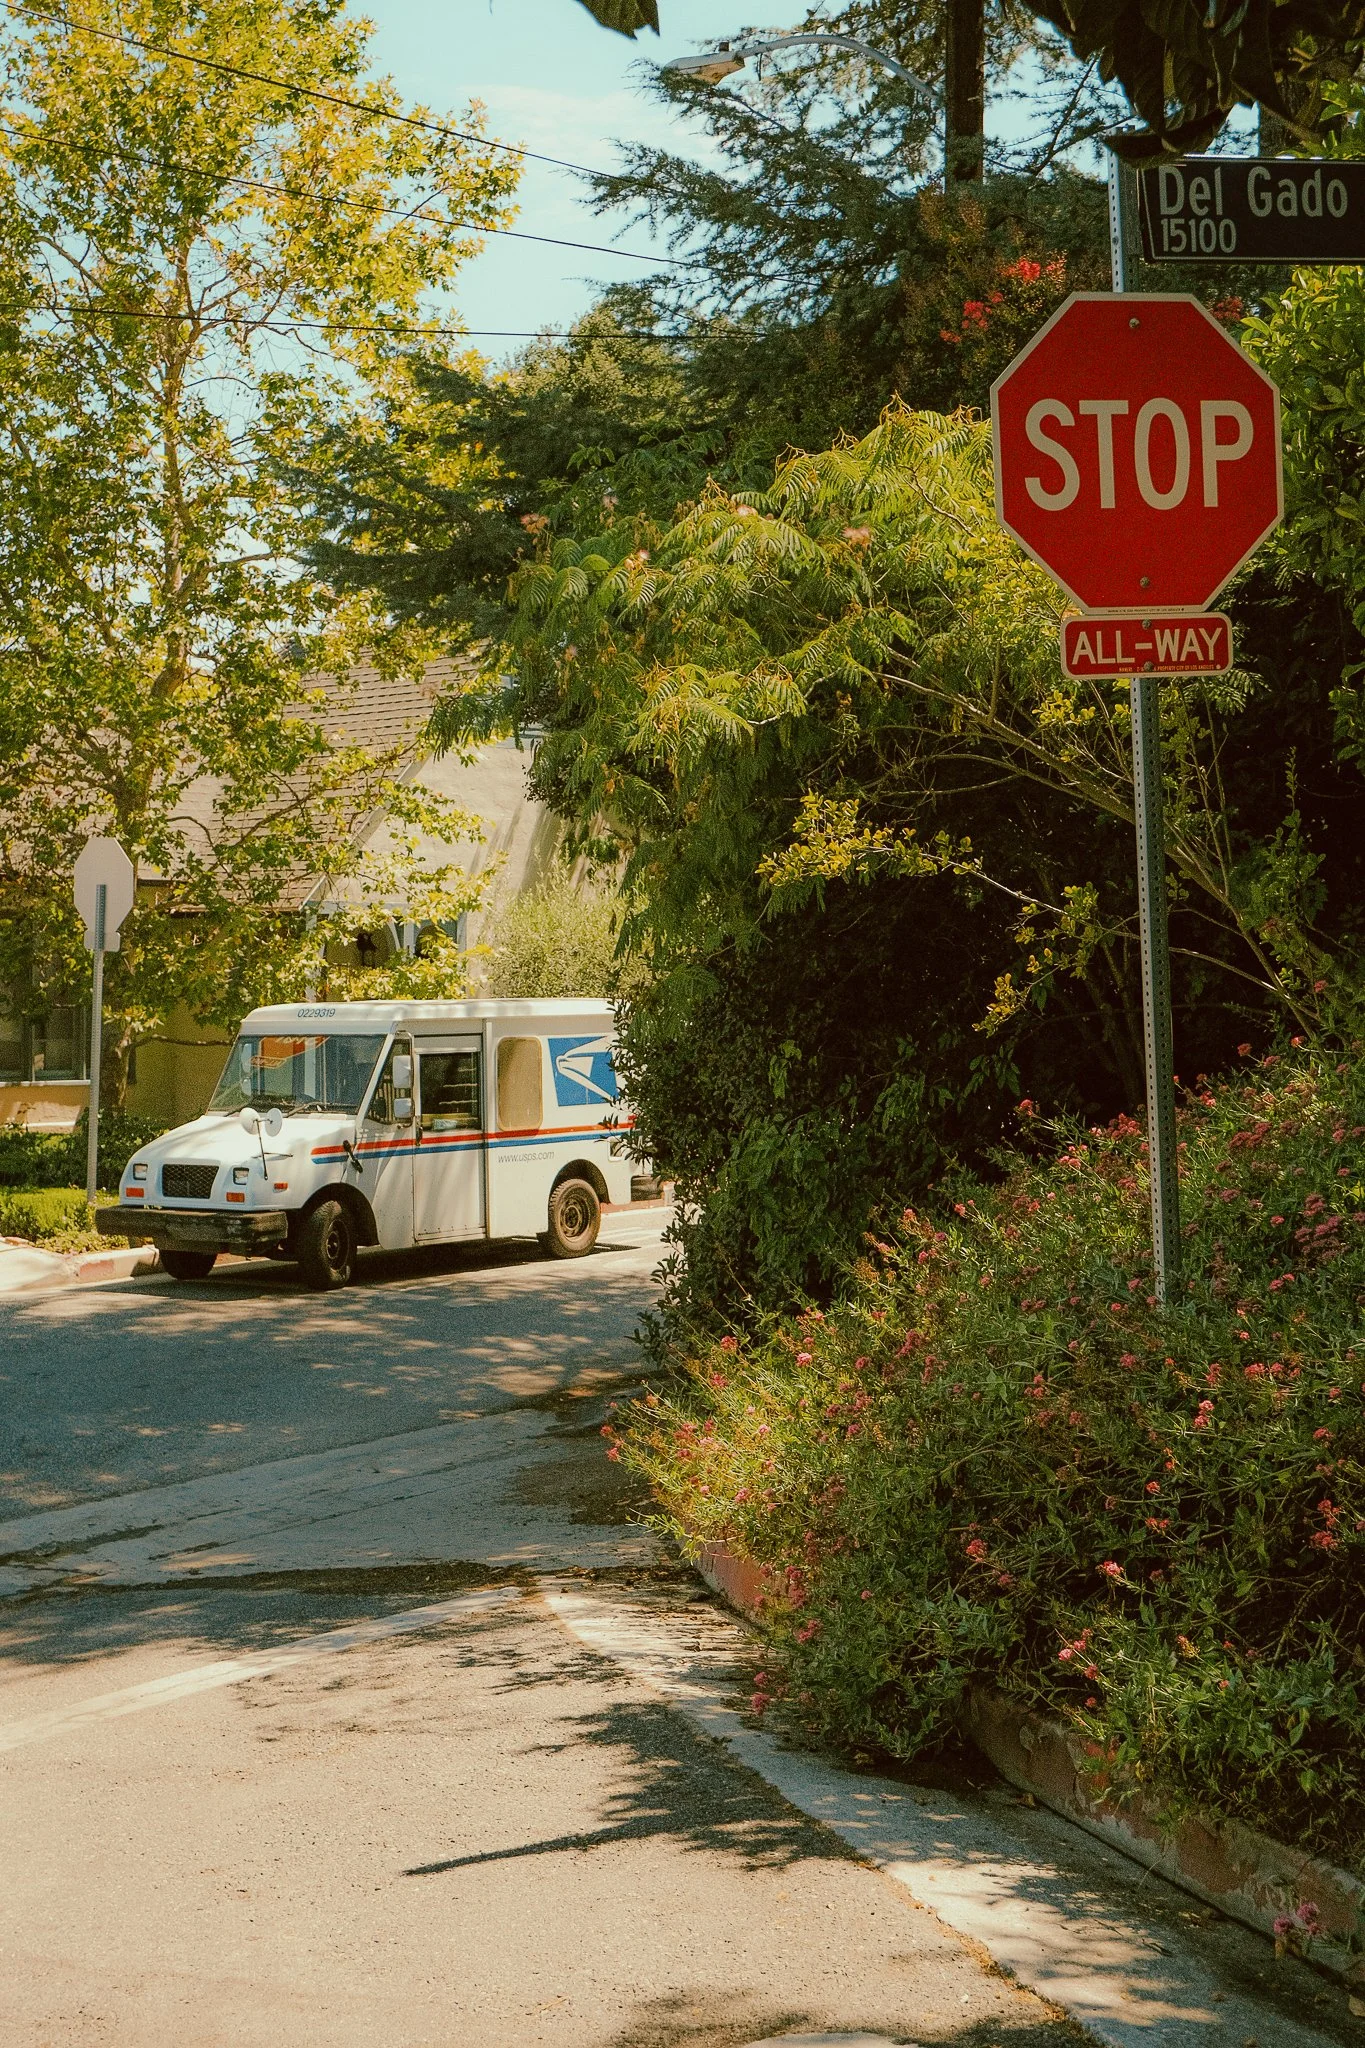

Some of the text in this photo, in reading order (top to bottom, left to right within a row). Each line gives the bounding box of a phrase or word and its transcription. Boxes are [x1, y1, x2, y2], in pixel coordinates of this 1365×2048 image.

[1158, 165, 1348, 218] Del Gado
[1160, 218, 1237, 253] 15100
[1024, 397, 1254, 511] STOP
[1071, 627, 1223, 665] ALL-WAY
[297, 1008, 336, 1018] 0229319
[498, 1151, 555, 1163] www.usps.com
